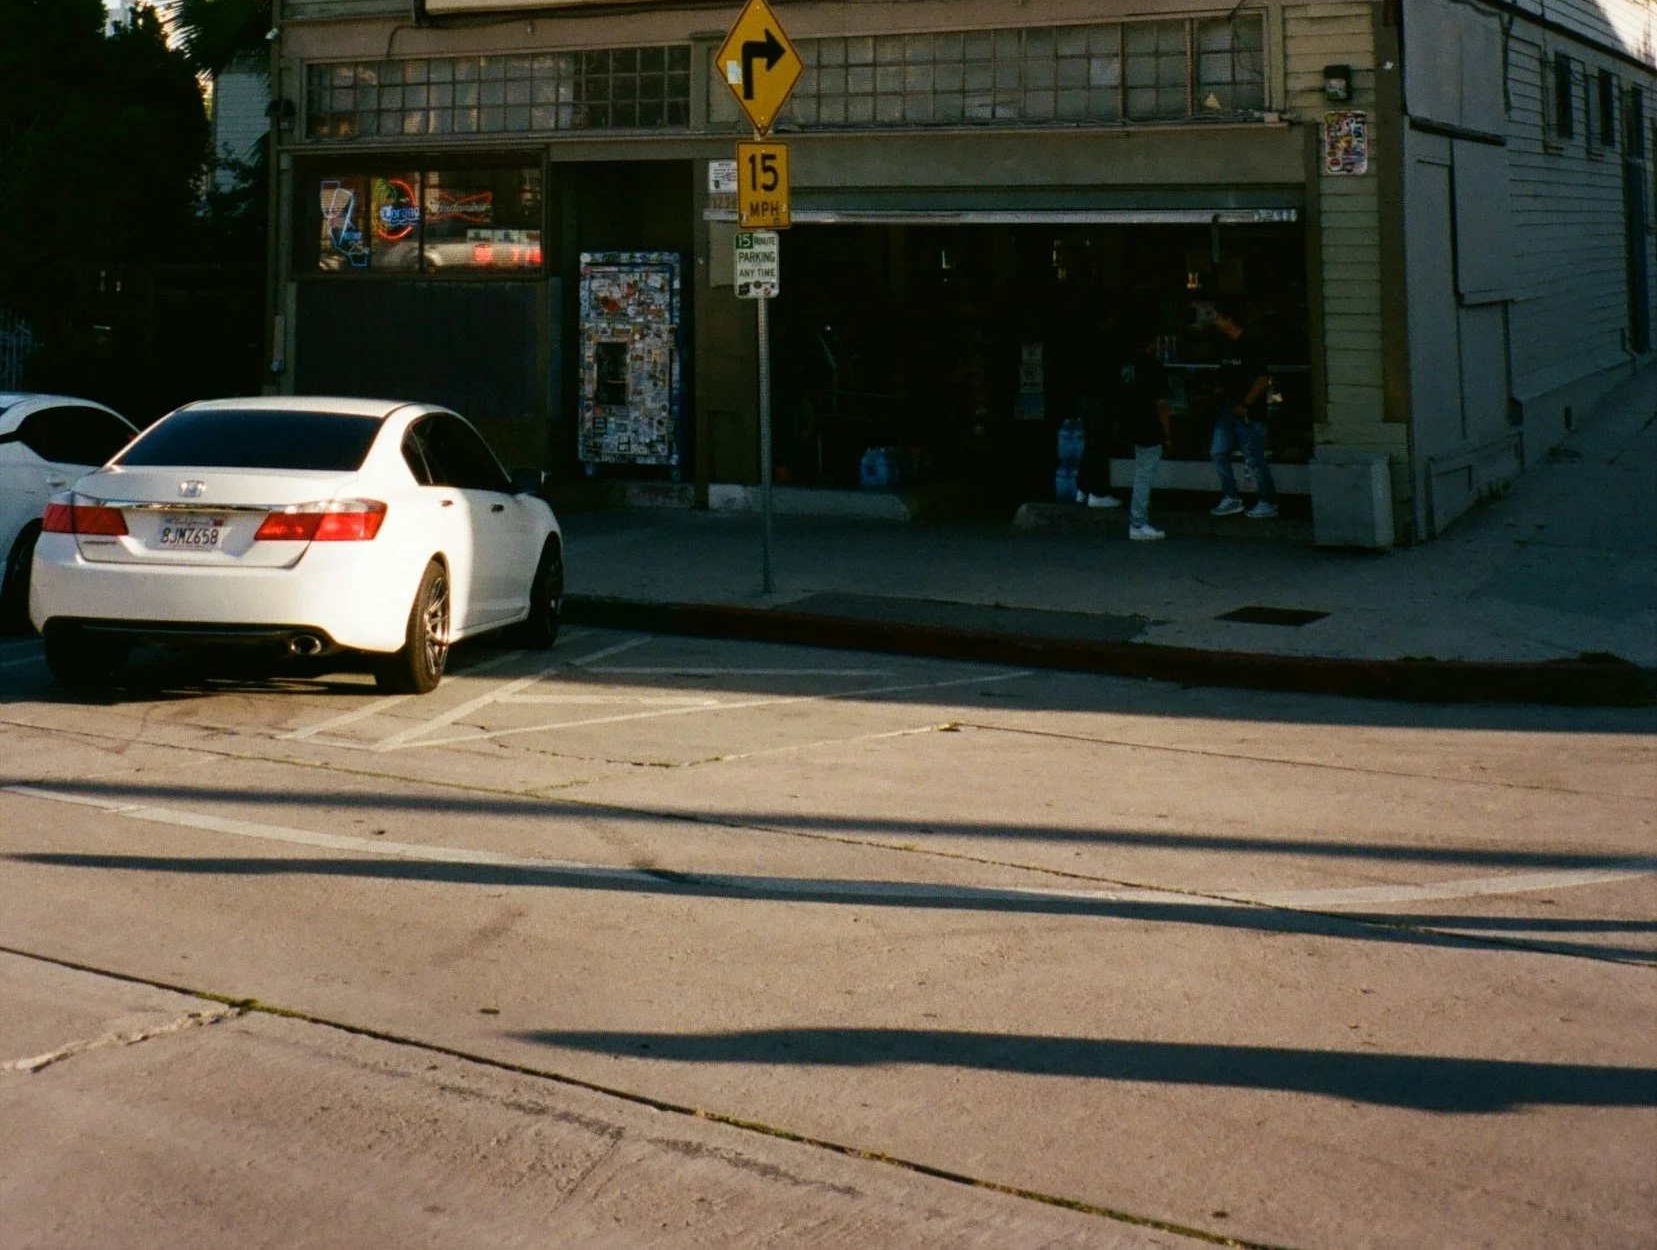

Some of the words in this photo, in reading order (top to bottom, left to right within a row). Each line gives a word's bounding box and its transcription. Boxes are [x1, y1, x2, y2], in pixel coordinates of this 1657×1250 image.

[748, 153, 779, 191] 15
[750, 201, 779, 217] MPH
[738, 234, 751, 247] 15
[738, 251, 776, 263] PARKING
[739, 268, 755, 277] ANY
[757, 268, 776, 277] TIME
